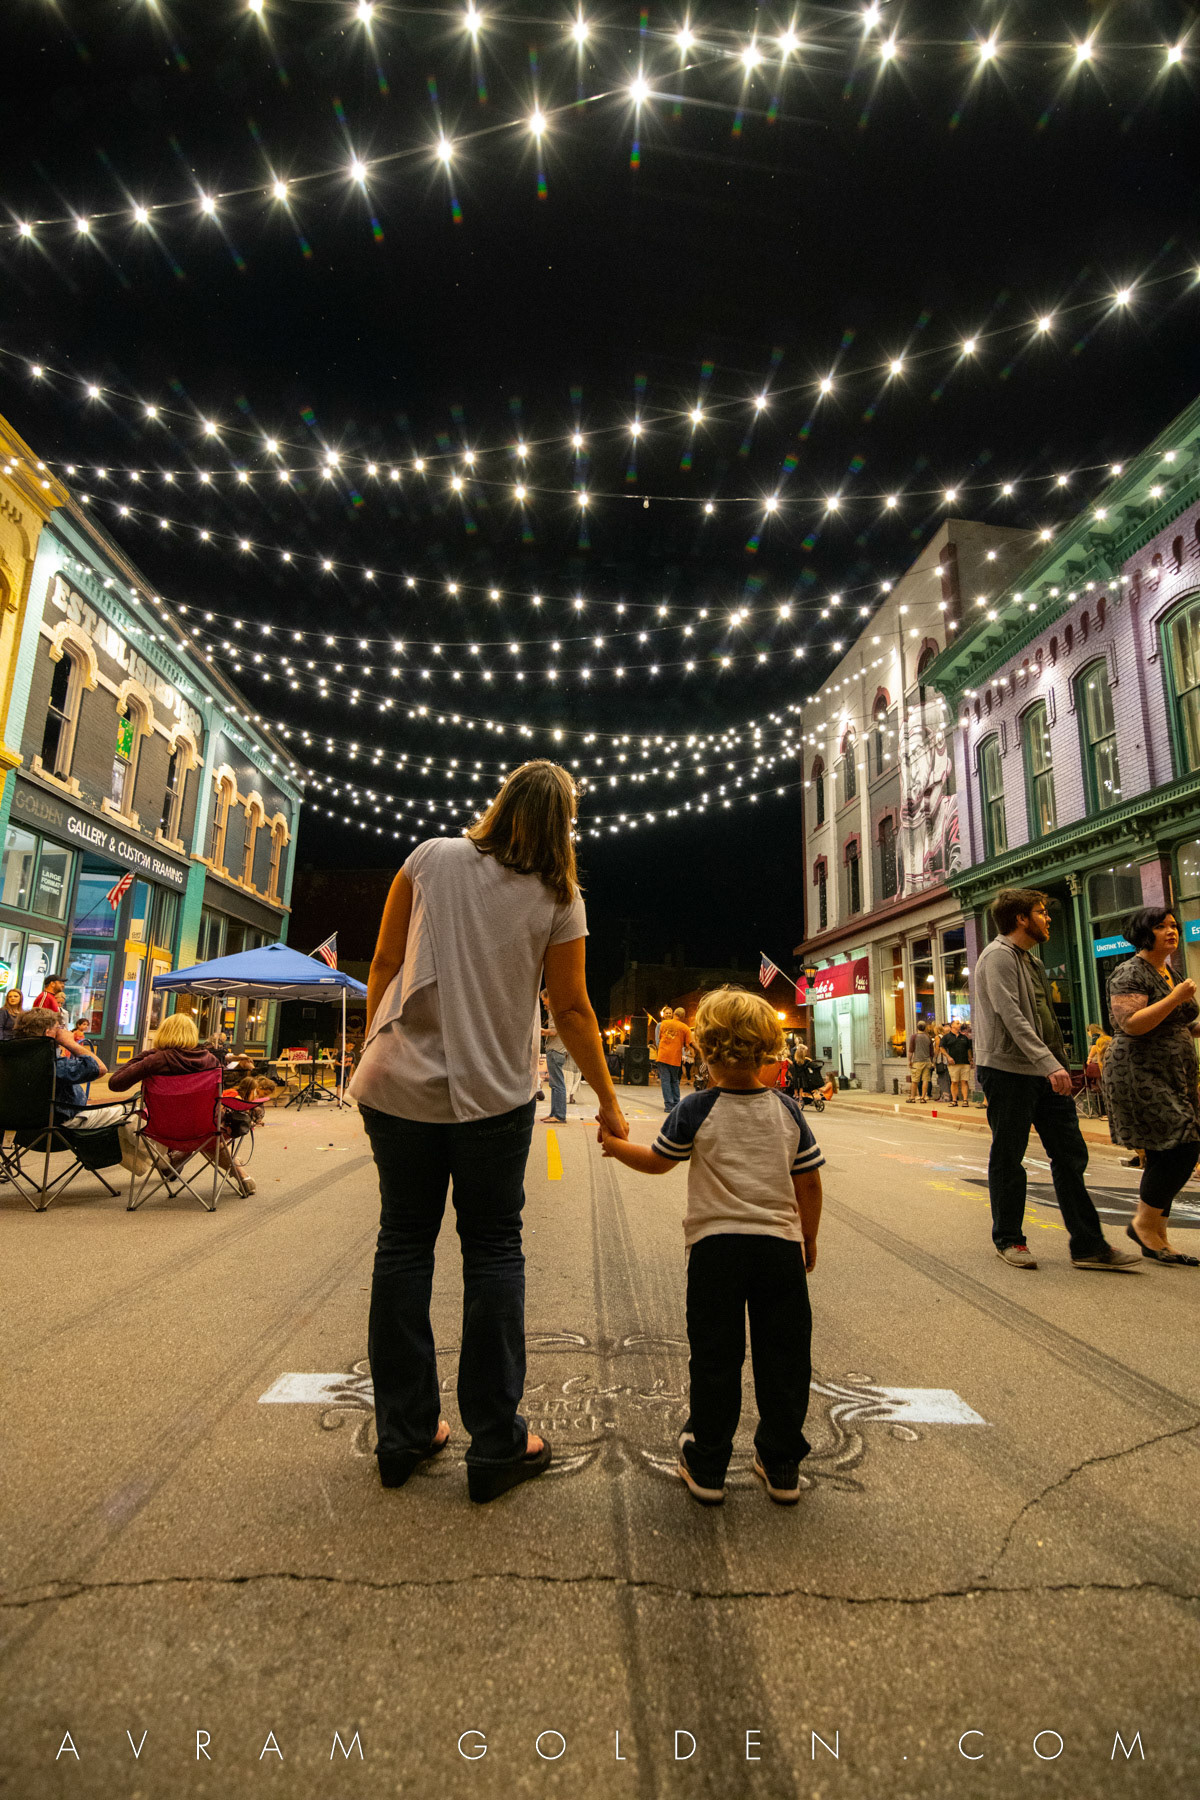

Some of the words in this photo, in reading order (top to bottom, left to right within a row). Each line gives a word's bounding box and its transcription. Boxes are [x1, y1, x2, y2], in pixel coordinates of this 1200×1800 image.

[52, 575, 174, 709] ESTABLISHED
[16, 790, 64, 827] GOLDEN
[67, 816, 108, 847] GALLERY
[109, 837, 116, 853] &
[118, 841, 151, 868] CUSTOM
[152, 858, 183, 884] FRAMING
[41, 876, 61, 889] FORMAT
[42, 870, 62, 882] LARGE
